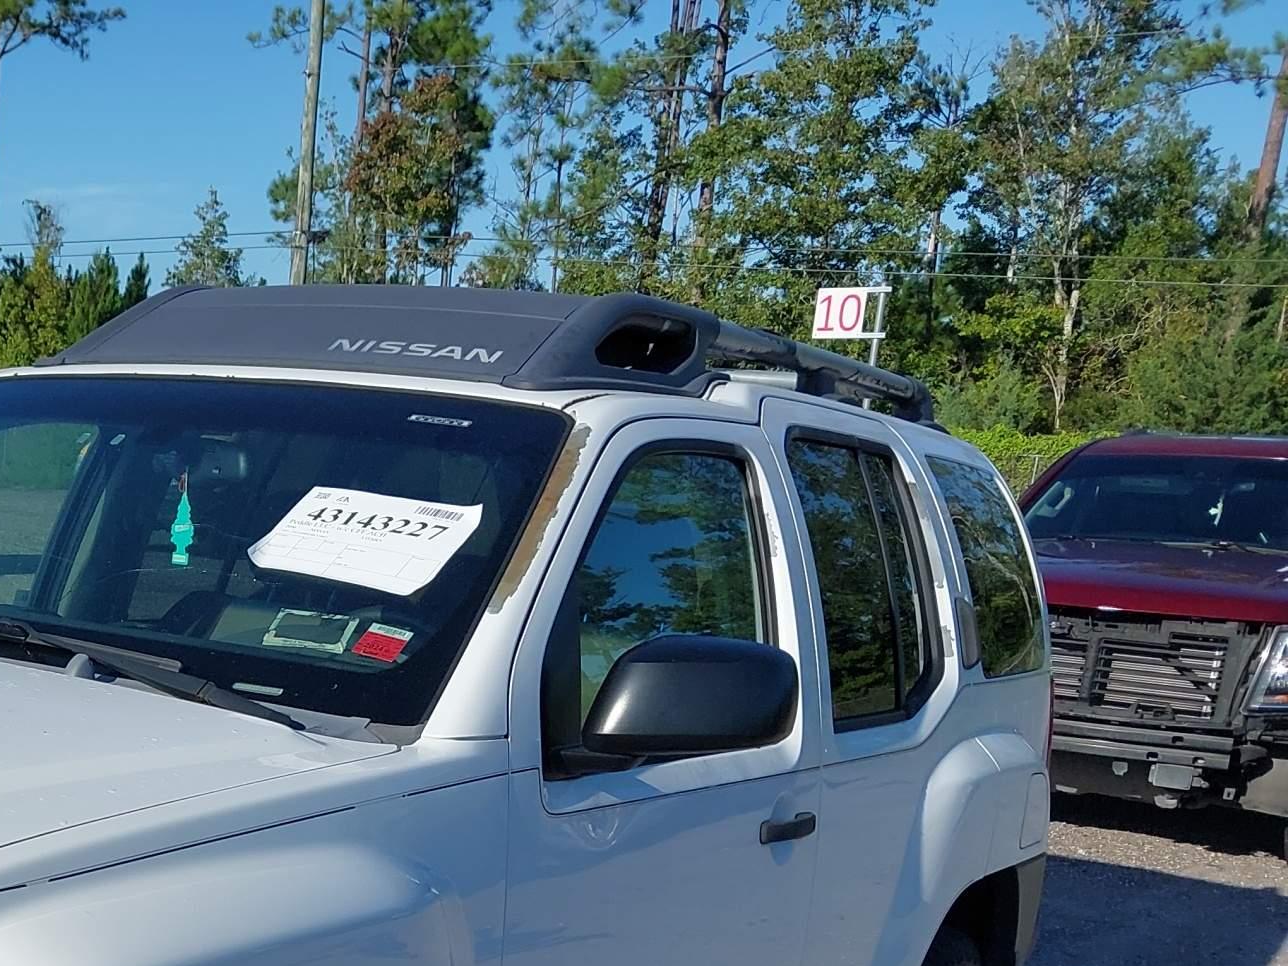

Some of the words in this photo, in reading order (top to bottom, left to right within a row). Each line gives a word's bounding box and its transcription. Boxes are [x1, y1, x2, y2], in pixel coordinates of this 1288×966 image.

[816, 294, 862, 331] 10
[327, 338, 504, 363] NISSAN
[306, 506, 449, 541] 43143227
